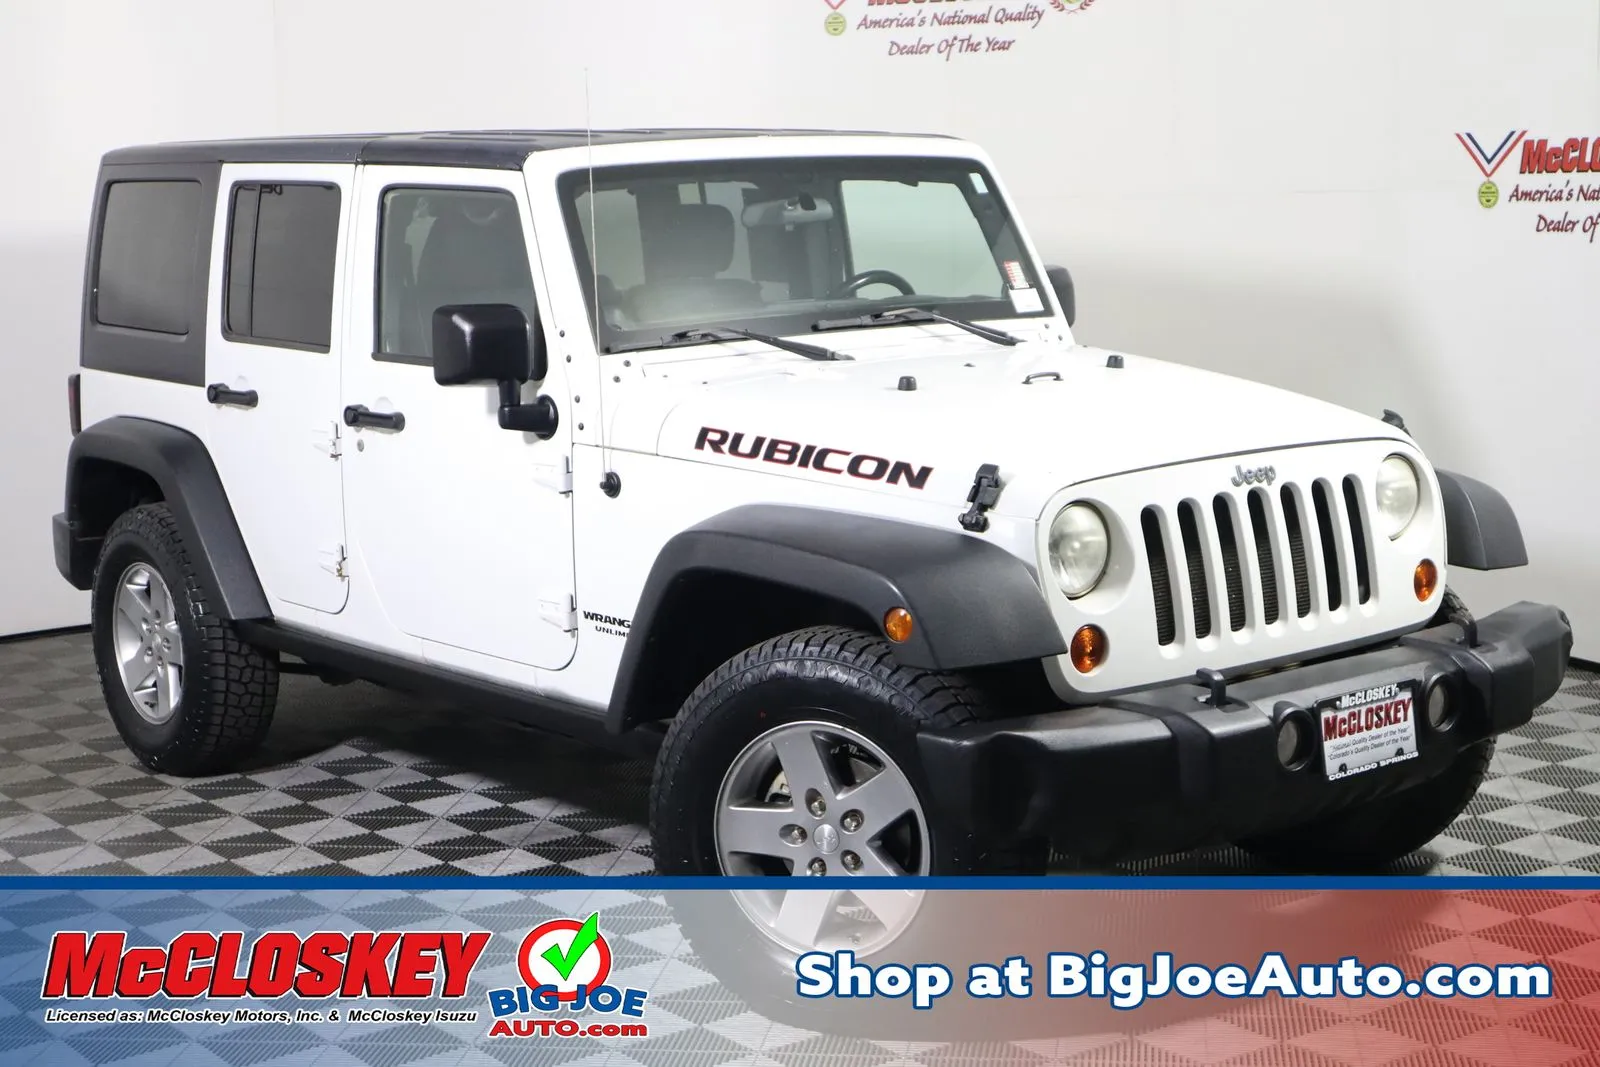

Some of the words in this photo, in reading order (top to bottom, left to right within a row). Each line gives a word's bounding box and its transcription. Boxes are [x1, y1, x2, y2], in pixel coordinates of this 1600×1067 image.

[857, 9, 926, 30] America's
[930, 6, 990, 26] National
[995, 3, 1045, 29] Quality
[888, 37, 934, 56] Dealer
[937, 35, 957, 61] Of
[958, 34, 982, 53] The
[985, 36, 1015, 52] Year
[1508, 179, 1574, 203] America's
[1536, 211, 1580, 233] Dealer
[694, 426, 934, 490] RUBICON
[1230, 464, 1277, 488] Jeep
[583, 610, 631, 628] WRANG
[1340, 683, 1398, 708] McCLOSKEY
[1323, 697, 1412, 741] McCLOSKEY
[1354, 743, 1371, 755] Quality
[1328, 762, 1378, 781] COLORADO
[1379, 751, 1419, 768] SPRINGS
